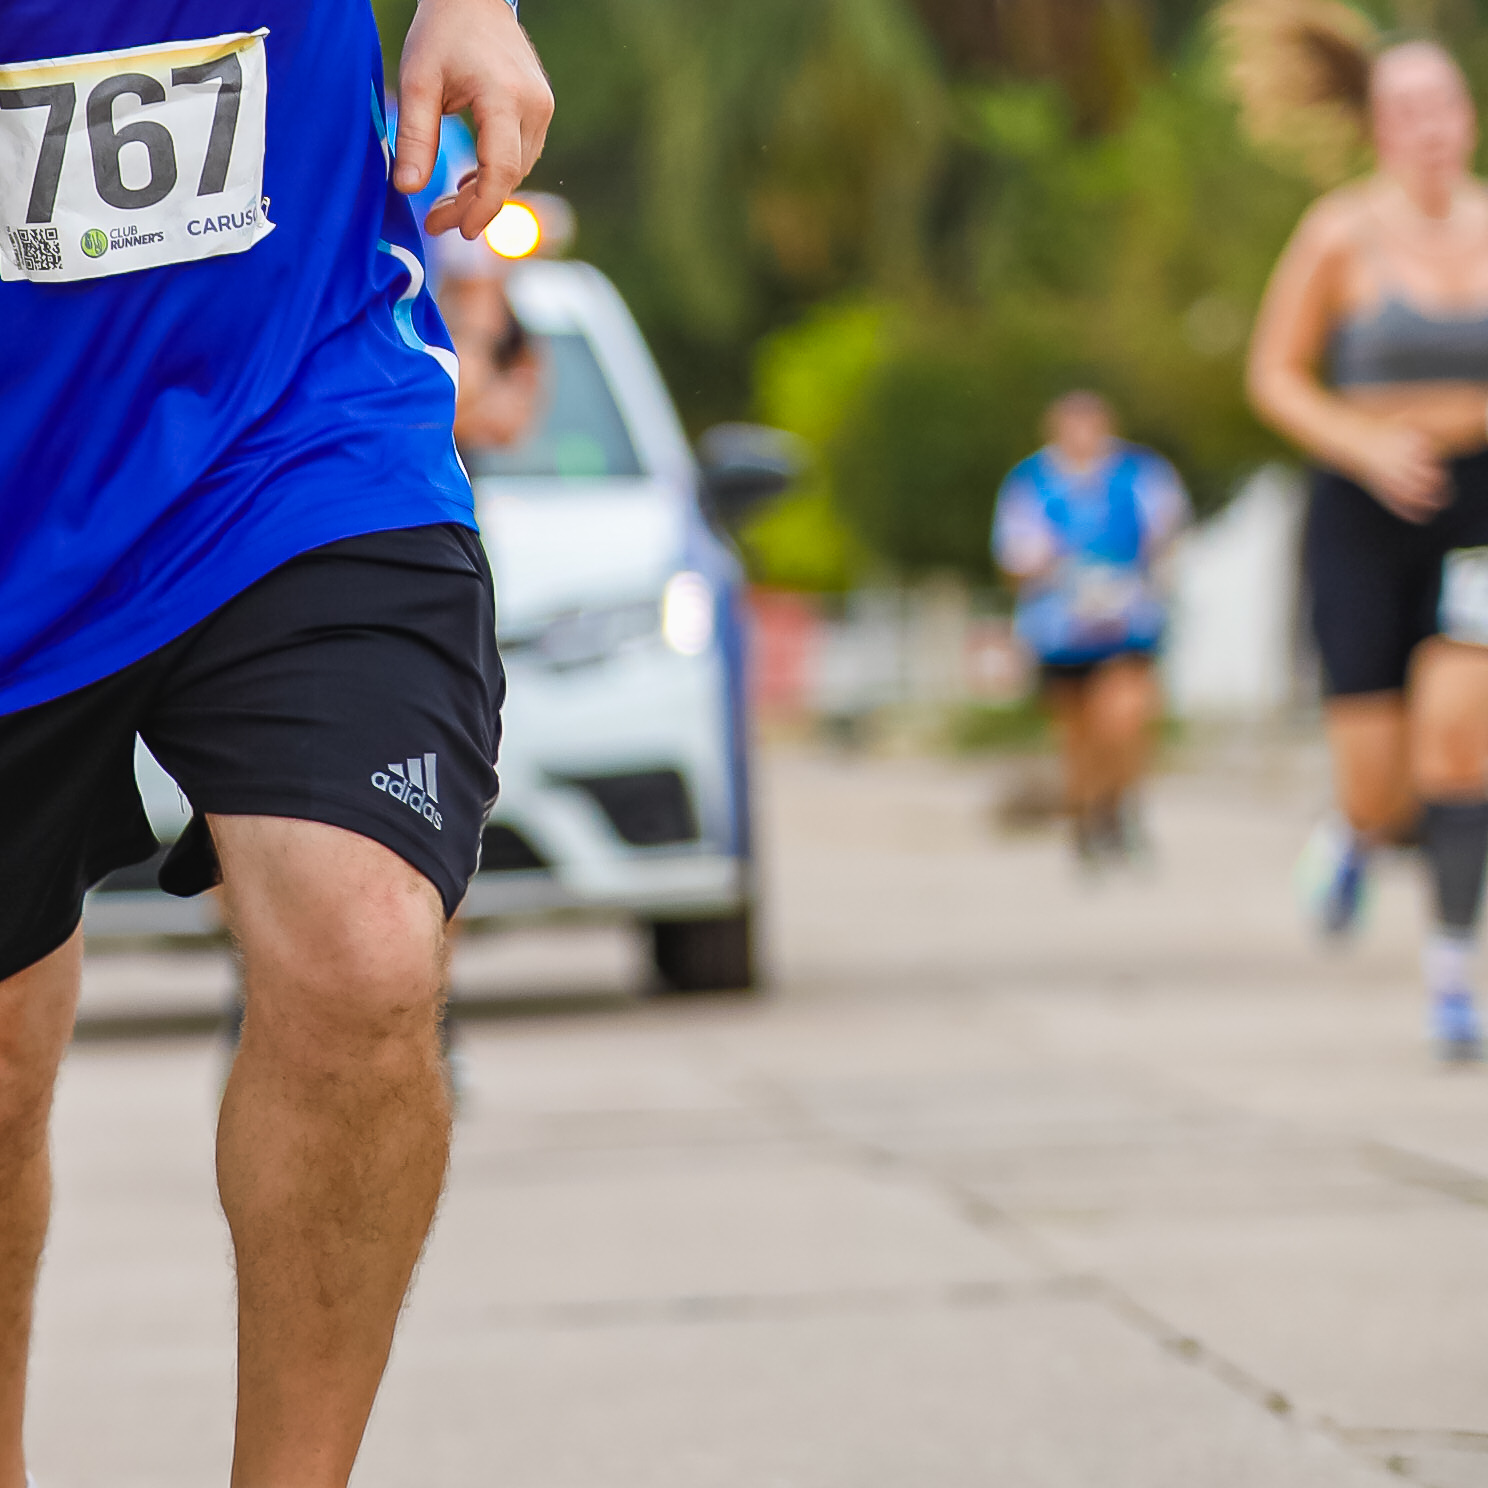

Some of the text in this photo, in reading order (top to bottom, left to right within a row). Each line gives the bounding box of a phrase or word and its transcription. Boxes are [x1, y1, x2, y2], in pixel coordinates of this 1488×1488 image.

[110, 225, 138, 239] CLUB
[110, 231, 164, 251] RUNNER'S
[371, 772, 443, 831] adidas
